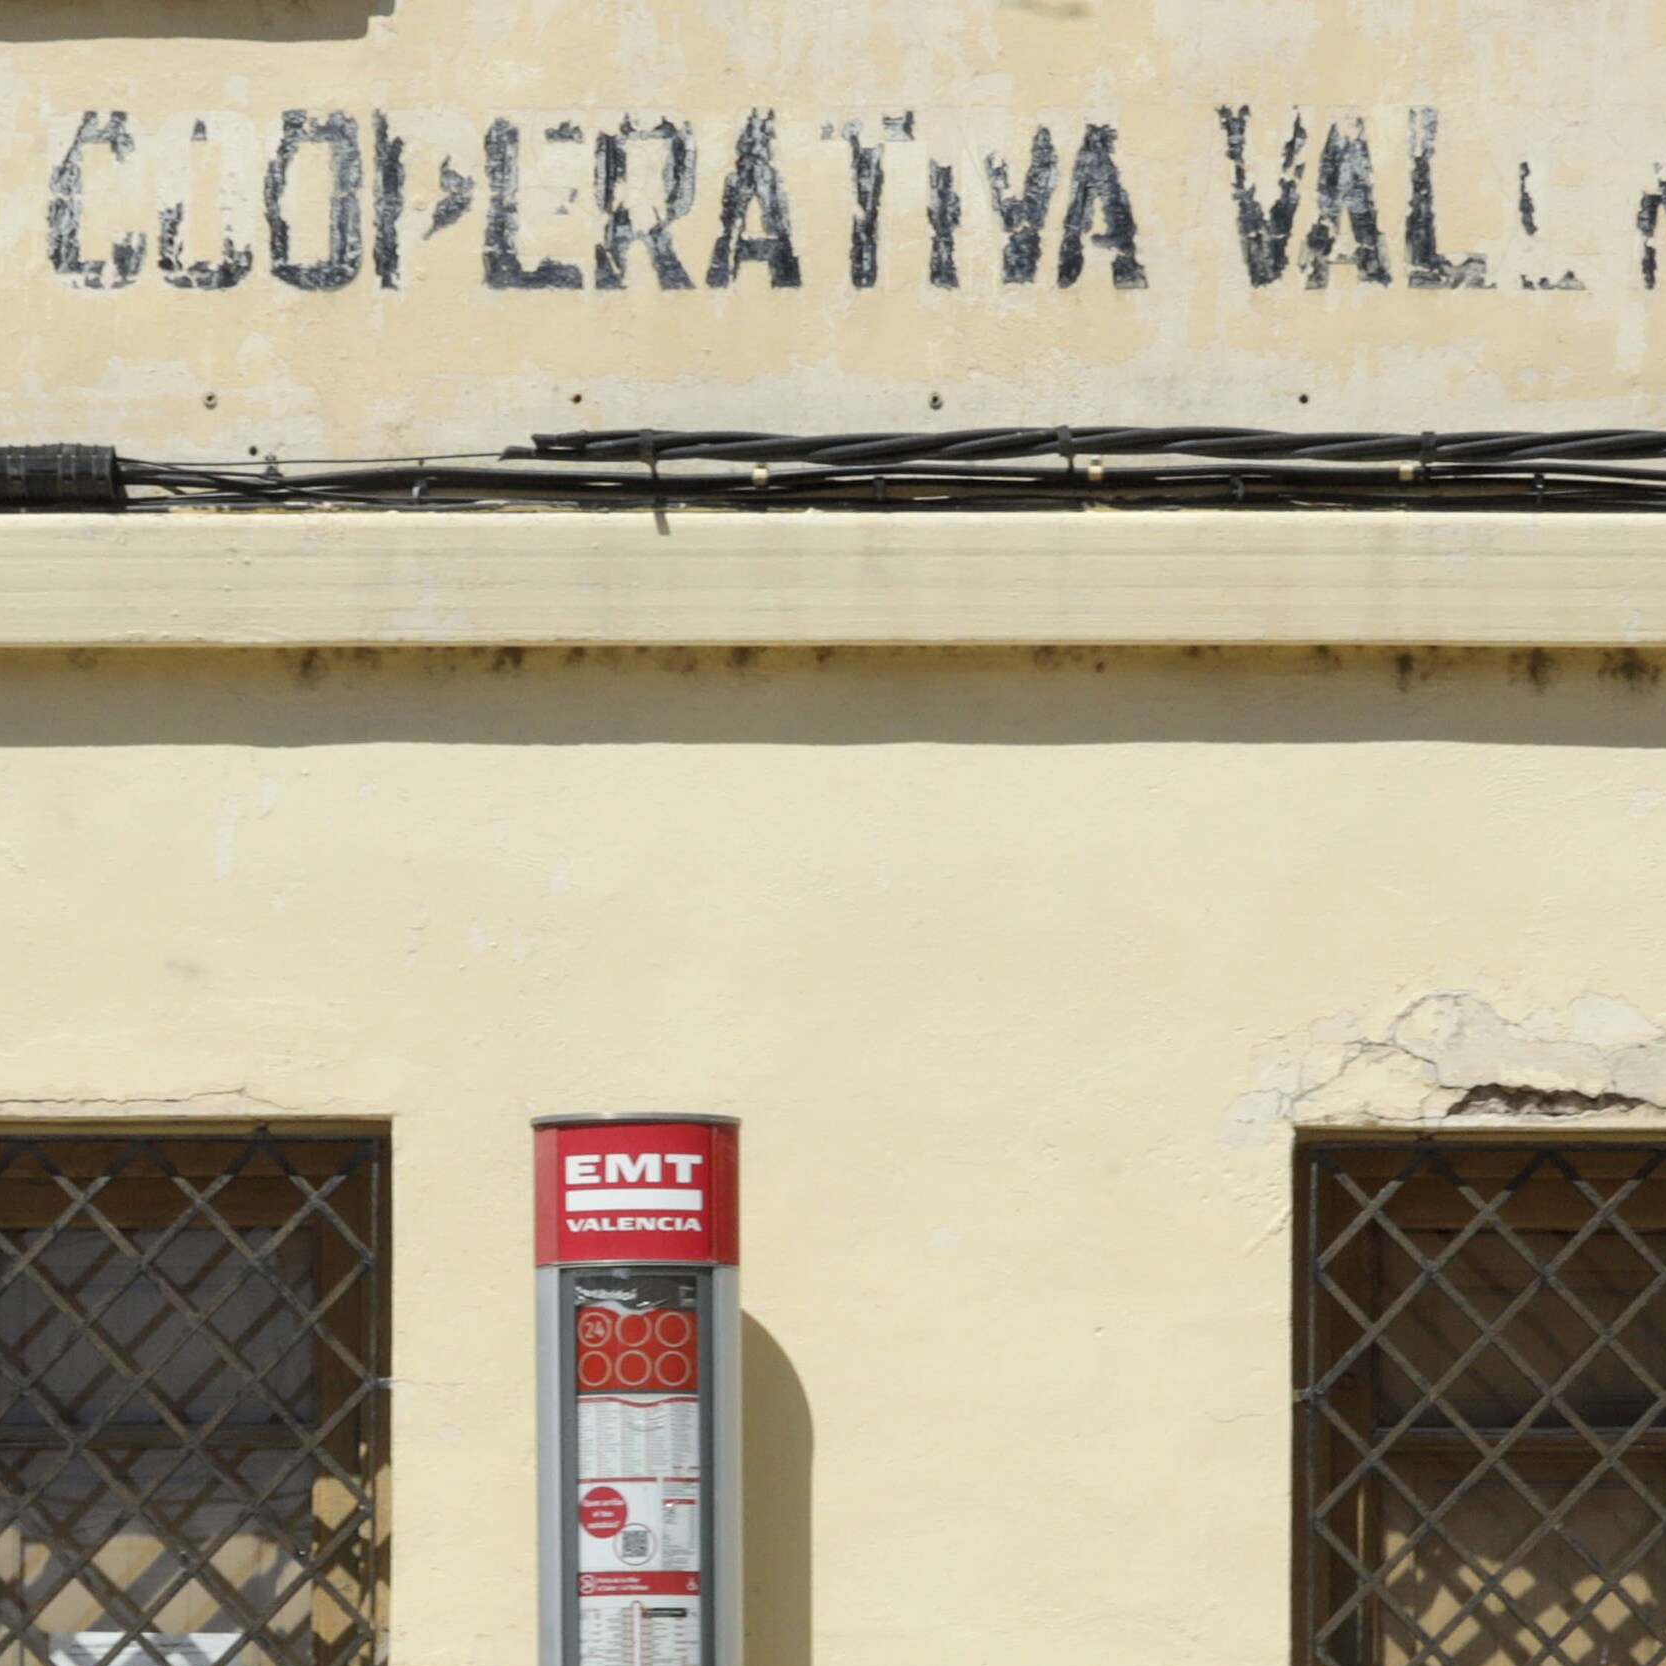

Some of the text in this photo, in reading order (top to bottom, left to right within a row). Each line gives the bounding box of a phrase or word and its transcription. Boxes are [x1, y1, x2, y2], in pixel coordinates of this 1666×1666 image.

[45, 105, 1149, 291] COOPERATIVA
[564, 1153, 704, 1185] EMT
[565, 1216, 703, 1232] VALENCIA
